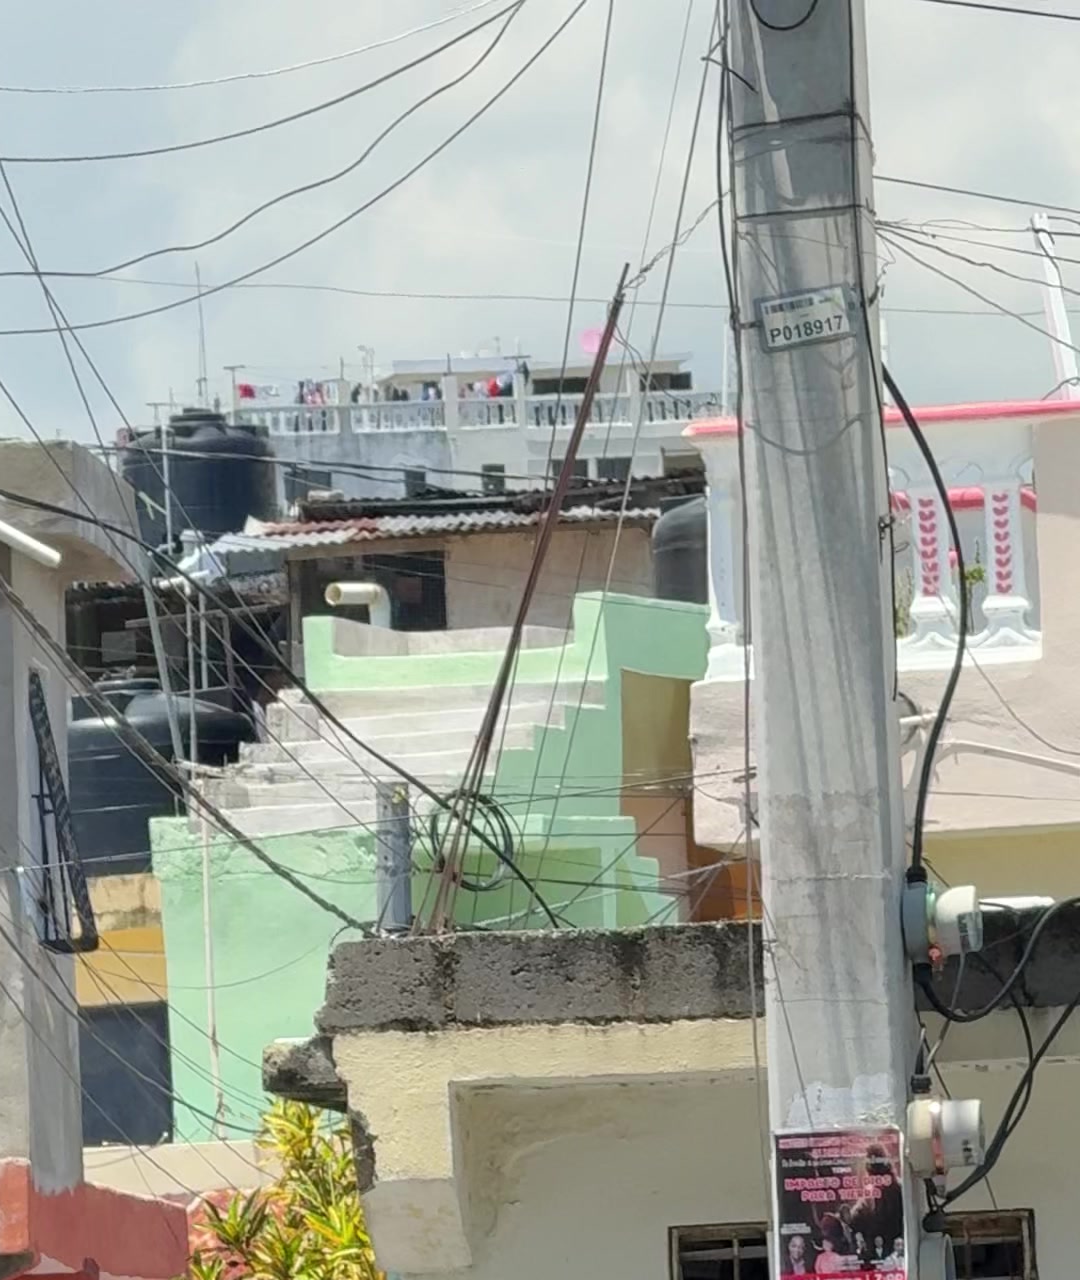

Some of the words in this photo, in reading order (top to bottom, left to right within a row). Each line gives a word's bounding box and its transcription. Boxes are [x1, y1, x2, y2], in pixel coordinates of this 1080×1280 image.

[769, 314, 843, 343] P018917
[842, 1175, 859, 1188] DE
[801, 1190, 836, 1202] PARA
